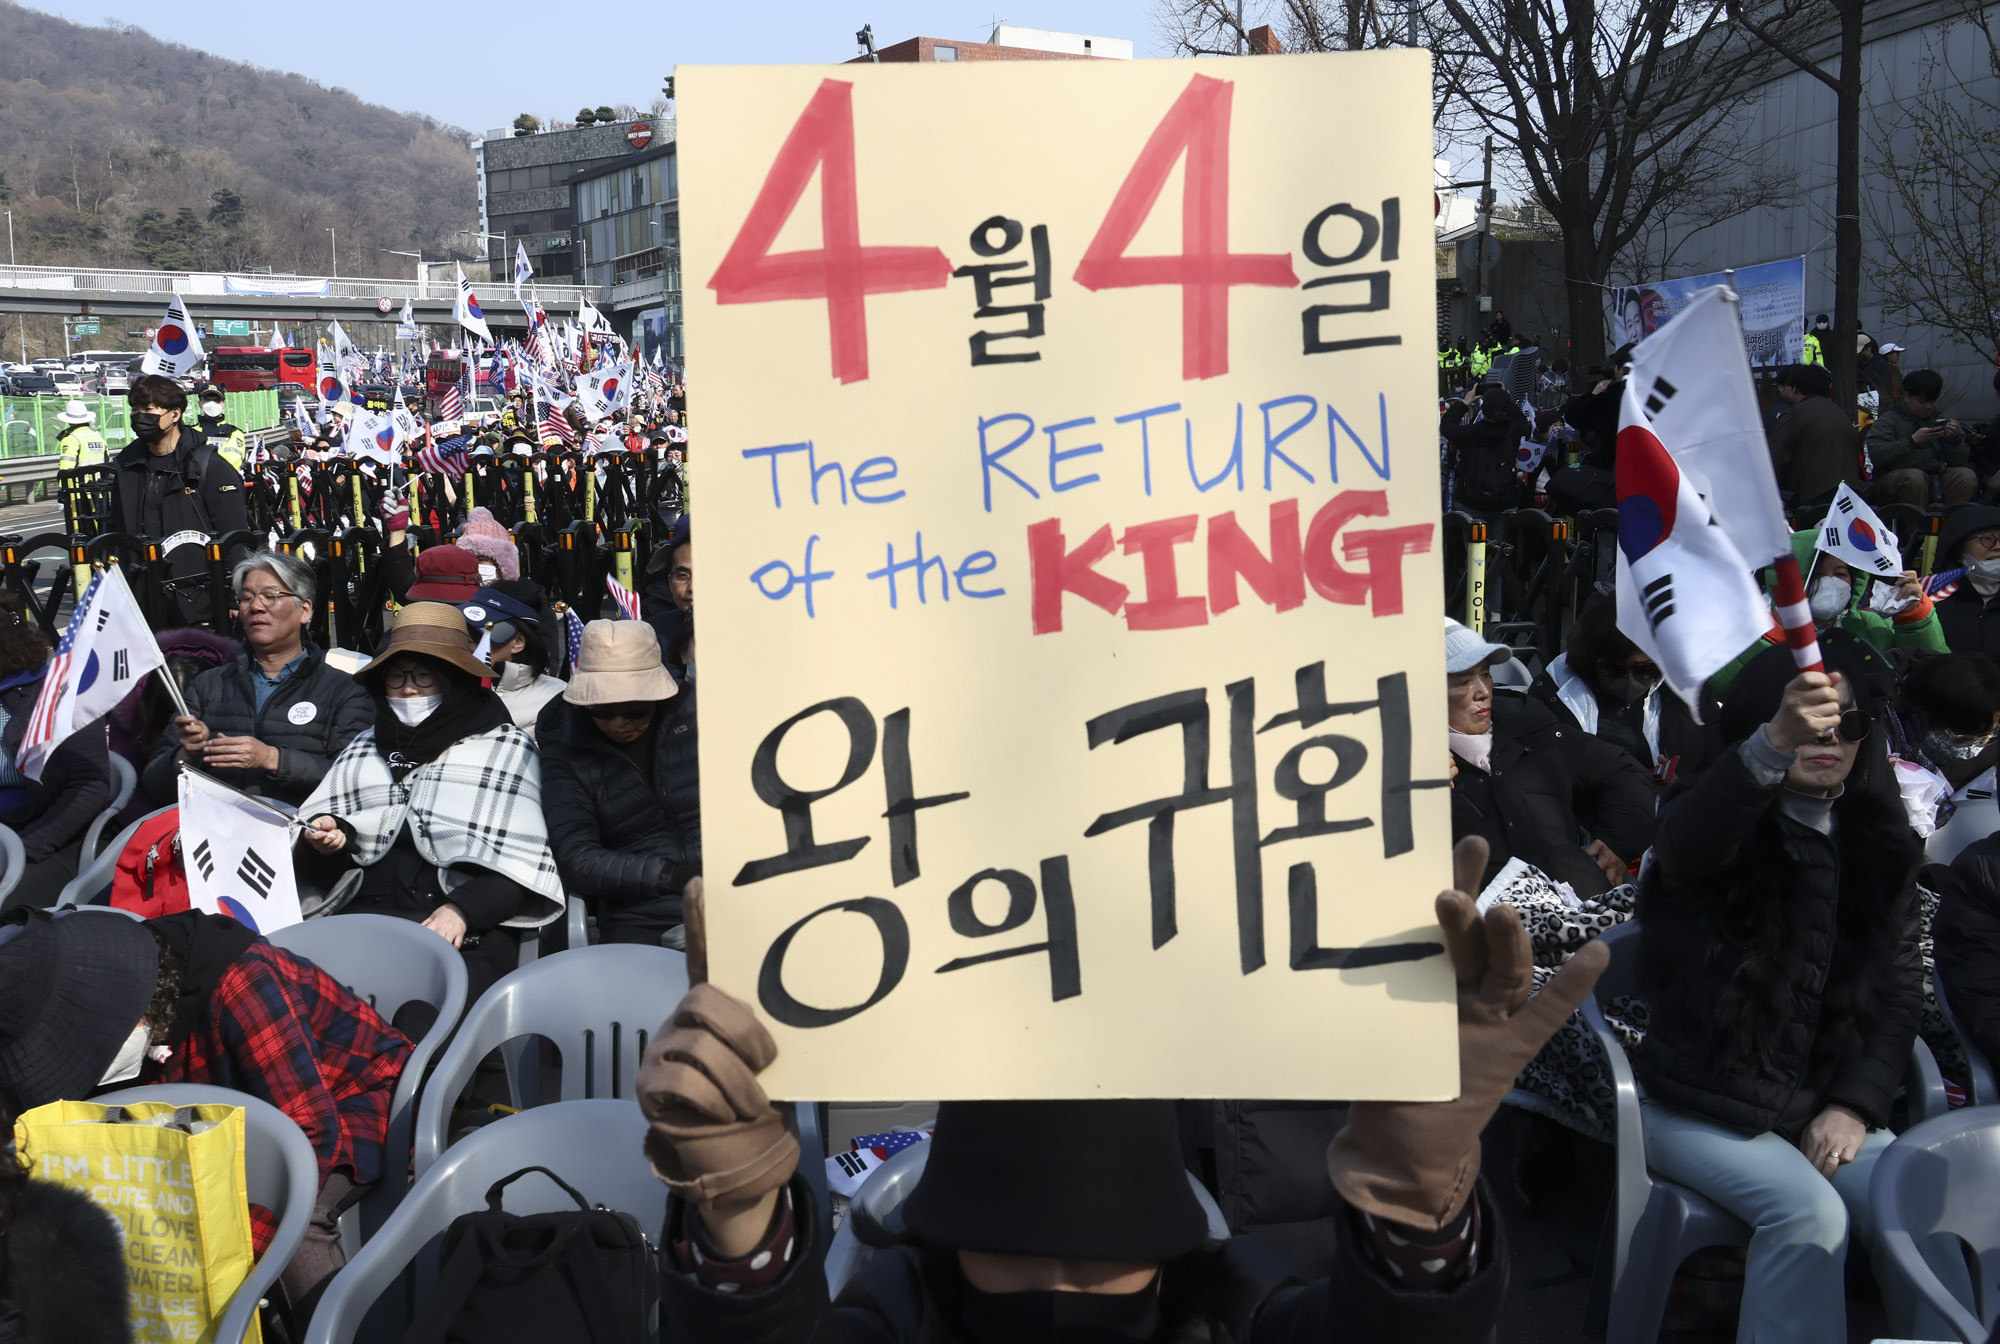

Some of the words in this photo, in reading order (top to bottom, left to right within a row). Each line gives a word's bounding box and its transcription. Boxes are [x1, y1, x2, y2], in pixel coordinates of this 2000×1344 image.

[707, 78, 1051, 384] 4월
[1073, 73, 1401, 380] 4일
[741, 440, 906, 509] The
[978, 392, 1391, 512] RETURN
[750, 534, 835, 618] of
[866, 531, 1006, 609] the
[1028, 489, 1434, 635] KING
[732, 697, 1081, 1028] 왕의
[1084, 661, 1450, 975] 귀환
[103, 1155, 193, 1188] LITTLE
[154, 1191, 194, 1215] AND
[129, 1213, 134, 1234] I
[139, 1215, 197, 1241] LOVE
[129, 1241, 197, 1268] CLEAN
[150, 1318, 198, 1339] SAVE
